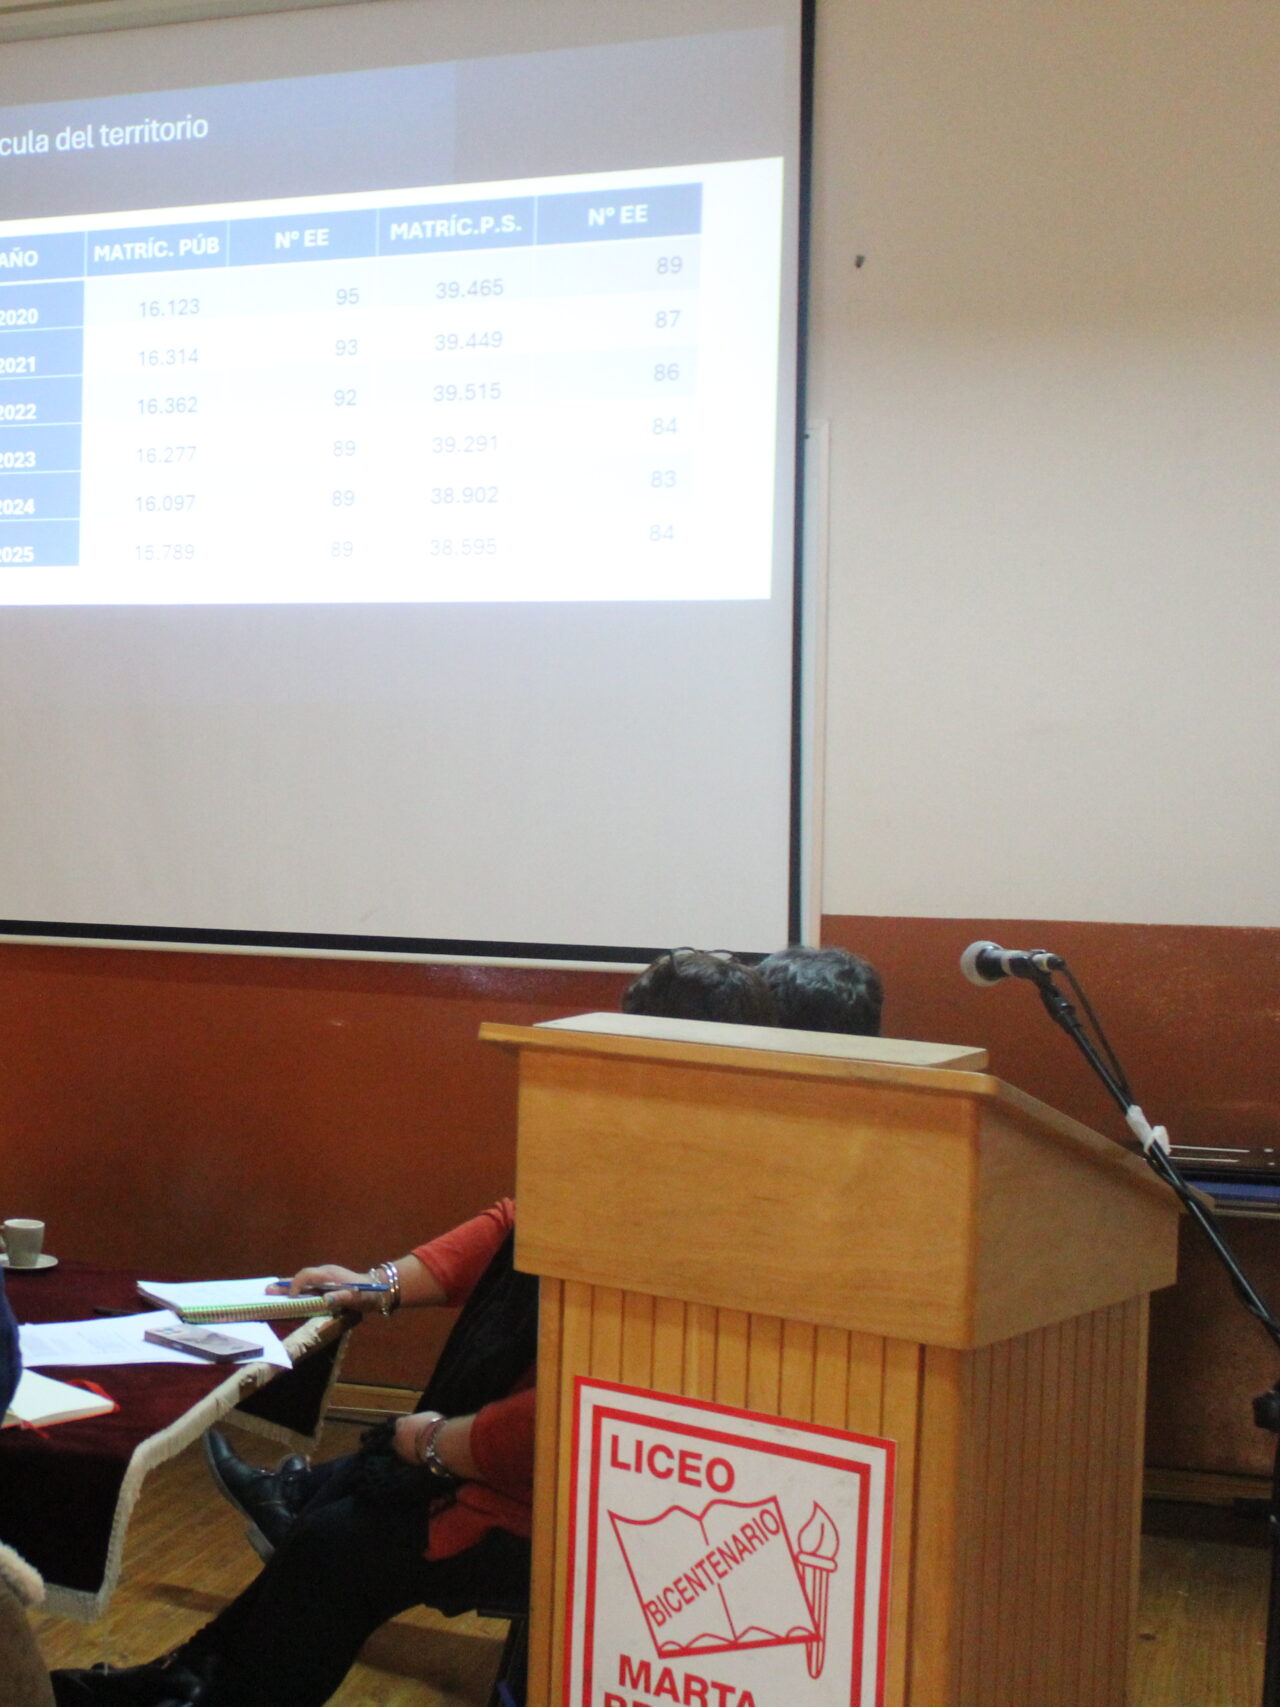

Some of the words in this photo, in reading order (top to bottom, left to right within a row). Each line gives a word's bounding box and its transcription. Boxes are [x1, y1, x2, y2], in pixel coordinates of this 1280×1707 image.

[55, 124, 95, 151] del
[99, 114, 209, 147] territorio
[93, 238, 174, 262] MATRÍC.
[179, 233, 220, 257] PÚB
[304, 228, 330, 247] EE
[390, 213, 523, 241] MATRÍC.P.S.
[621, 204, 649, 224] EE
[138, 298, 201, 319] 16.123
[335, 287, 360, 306] 95
[435, 278, 505, 300] 39.465
[656, 256, 683, 275] 89
[137, 347, 200, 367] 16.314
[335, 338, 358, 357] 93
[434, 330, 504, 351] 39.449
[654, 310, 681, 329] 87
[136, 396, 199, 416] 16.362
[333, 388, 358, 407] 92
[432, 382, 503, 403] 39.515
[652, 363, 680, 382] 86
[136, 445, 197, 464] 16.277
[332, 440, 357, 458] 89
[431, 434, 499, 454] 39.291
[651, 417, 679, 436] 84
[135, 494, 196, 513] 16.097
[331, 490, 356, 508] 89
[430, 486, 499, 505] 38.902
[650, 470, 678, 489] 83
[610, 1434, 735, 1493] LICEO
[646, 1508, 781, 1627] BICENTENARIO
